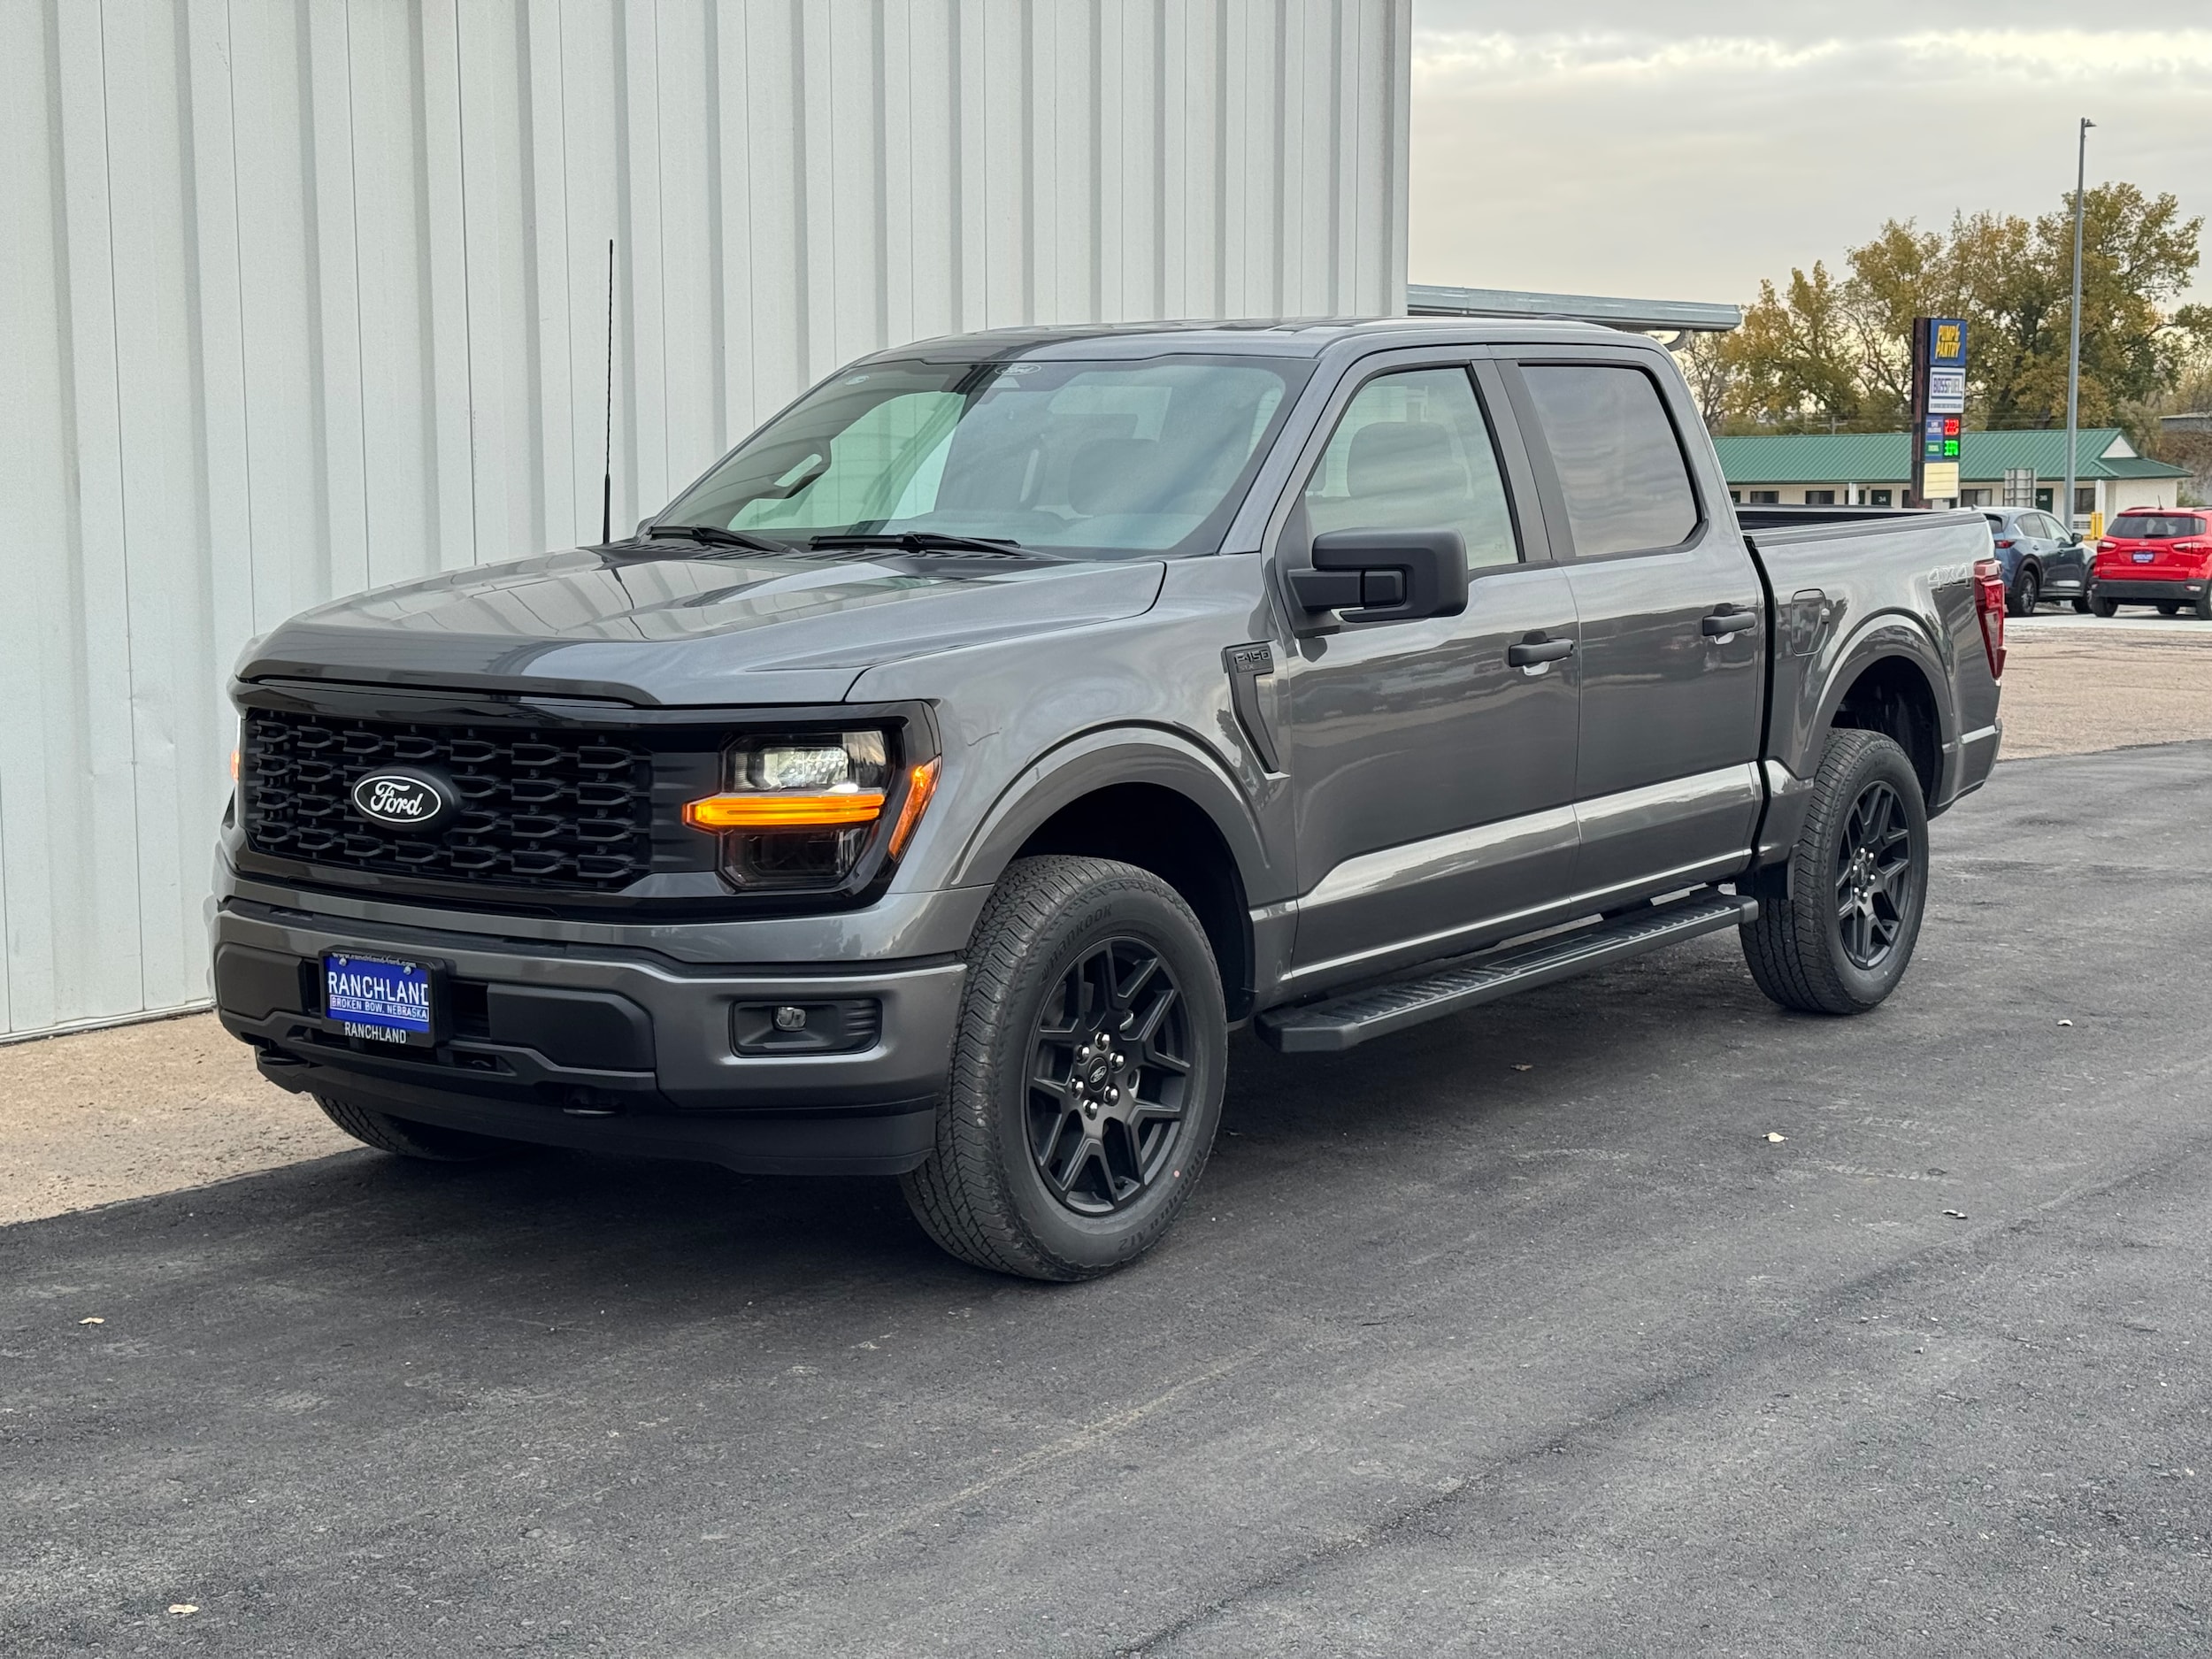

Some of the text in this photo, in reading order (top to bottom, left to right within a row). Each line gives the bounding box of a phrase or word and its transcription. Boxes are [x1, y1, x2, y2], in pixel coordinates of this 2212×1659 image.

[370, 780, 424, 816] Ford
[328, 972, 429, 1006] RANCHLAND
[331, 997, 362, 1010] BROKEN
[387, 1005, 427, 1019] NEBRASKA
[344, 1021, 407, 1044] RANCHLAND
